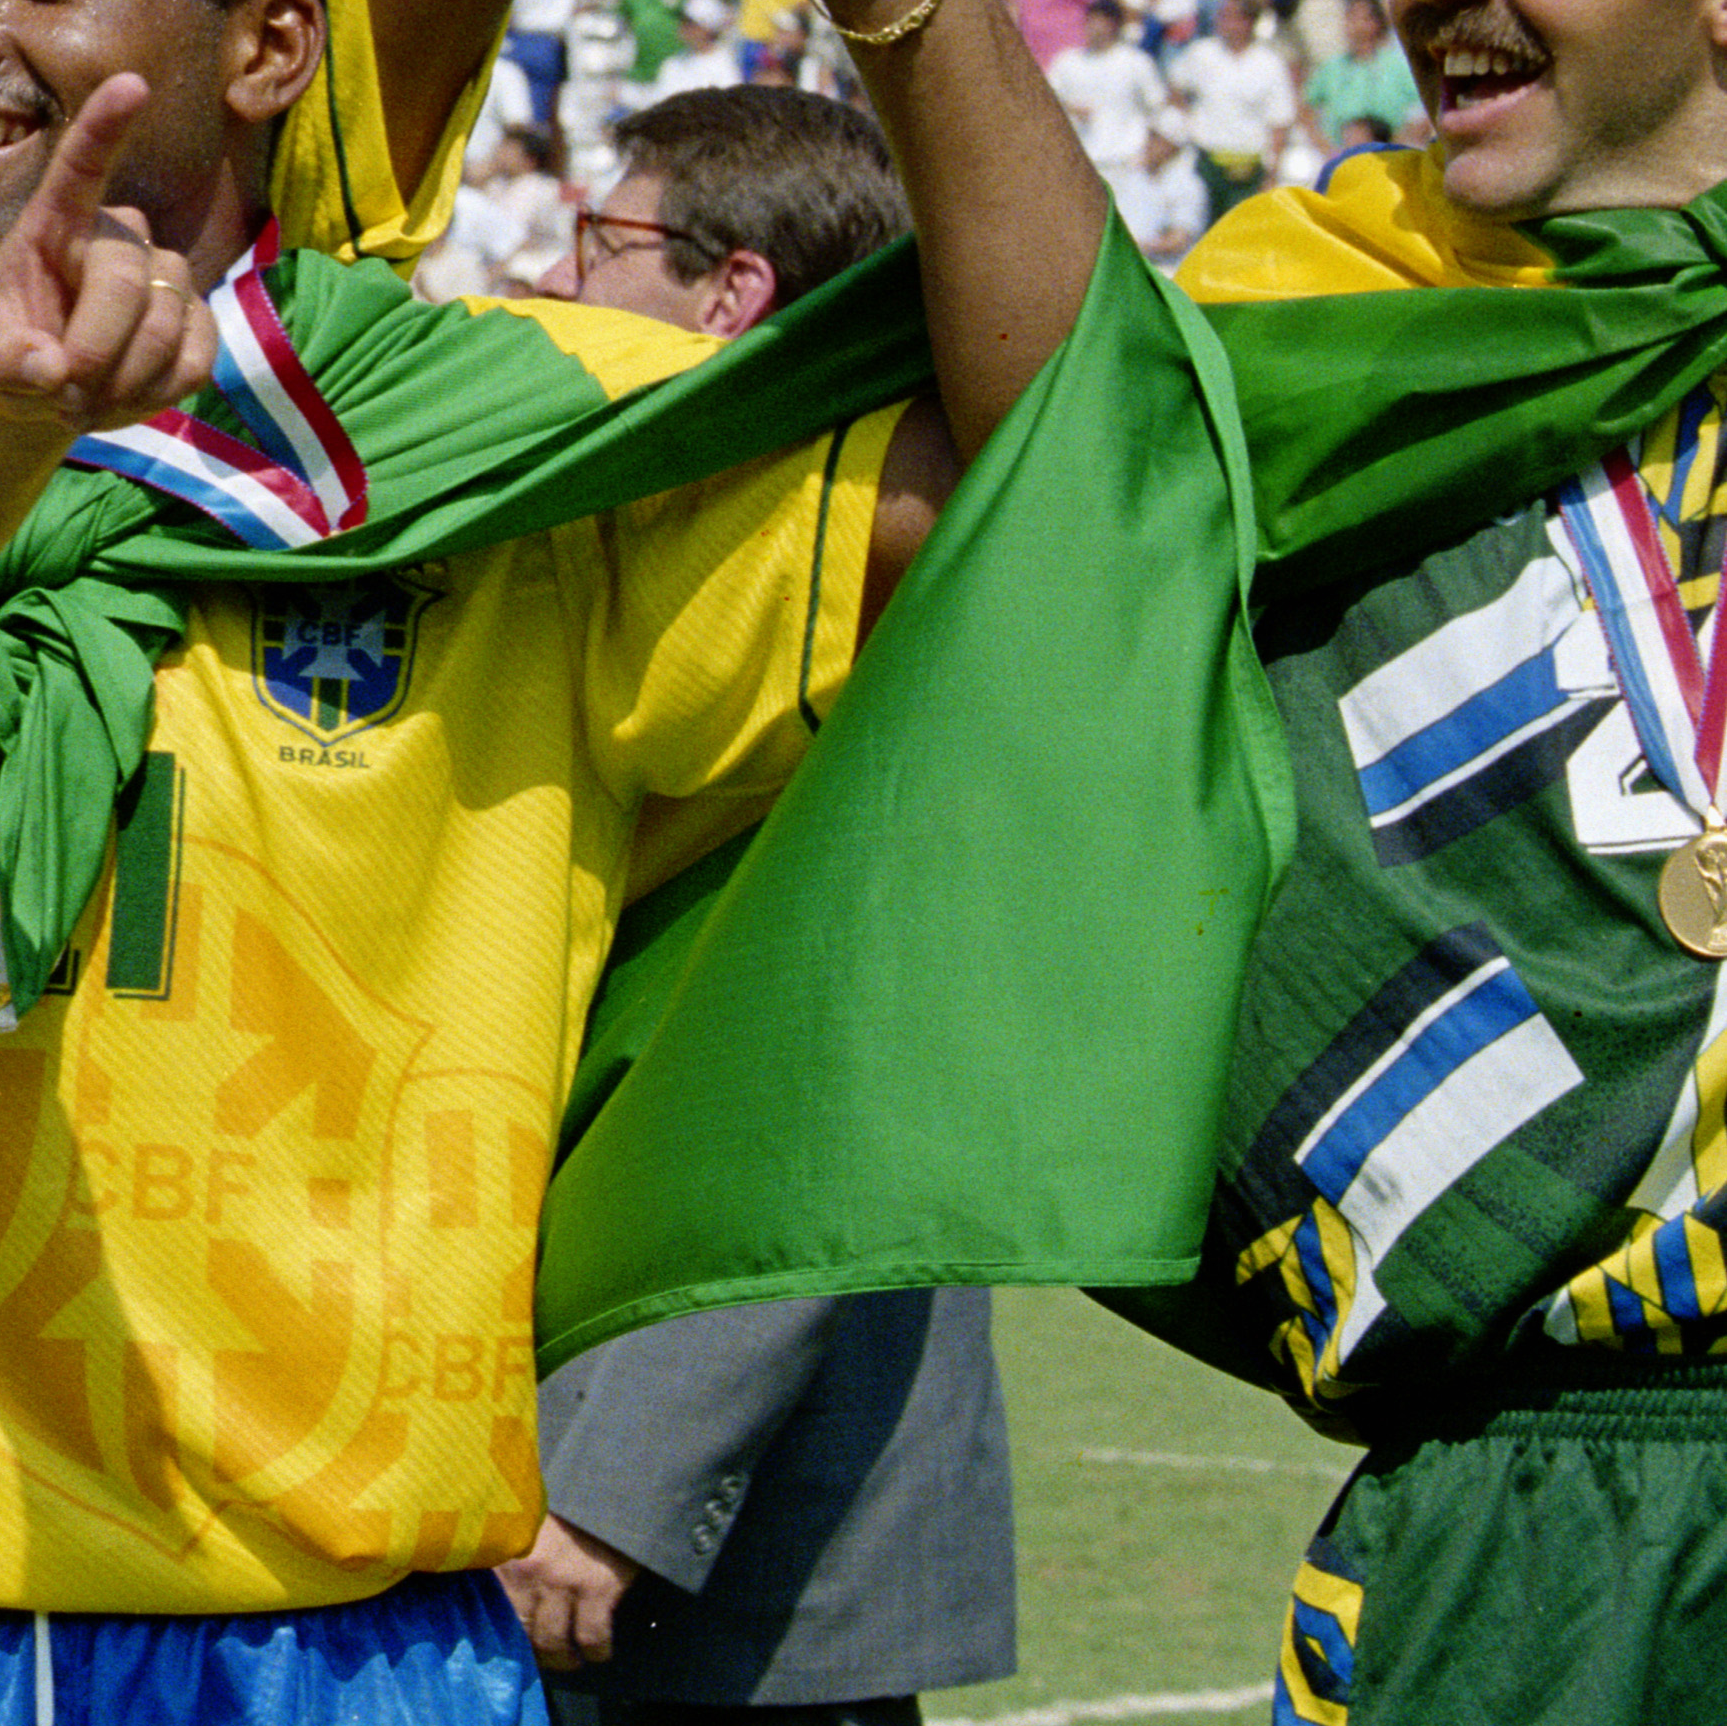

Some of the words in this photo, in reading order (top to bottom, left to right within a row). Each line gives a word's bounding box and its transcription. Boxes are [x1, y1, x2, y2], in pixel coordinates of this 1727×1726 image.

[297, 622, 363, 647] CBF
[279, 745, 370, 769] BRASIL
[71, 1139, 257, 1224] CBF
